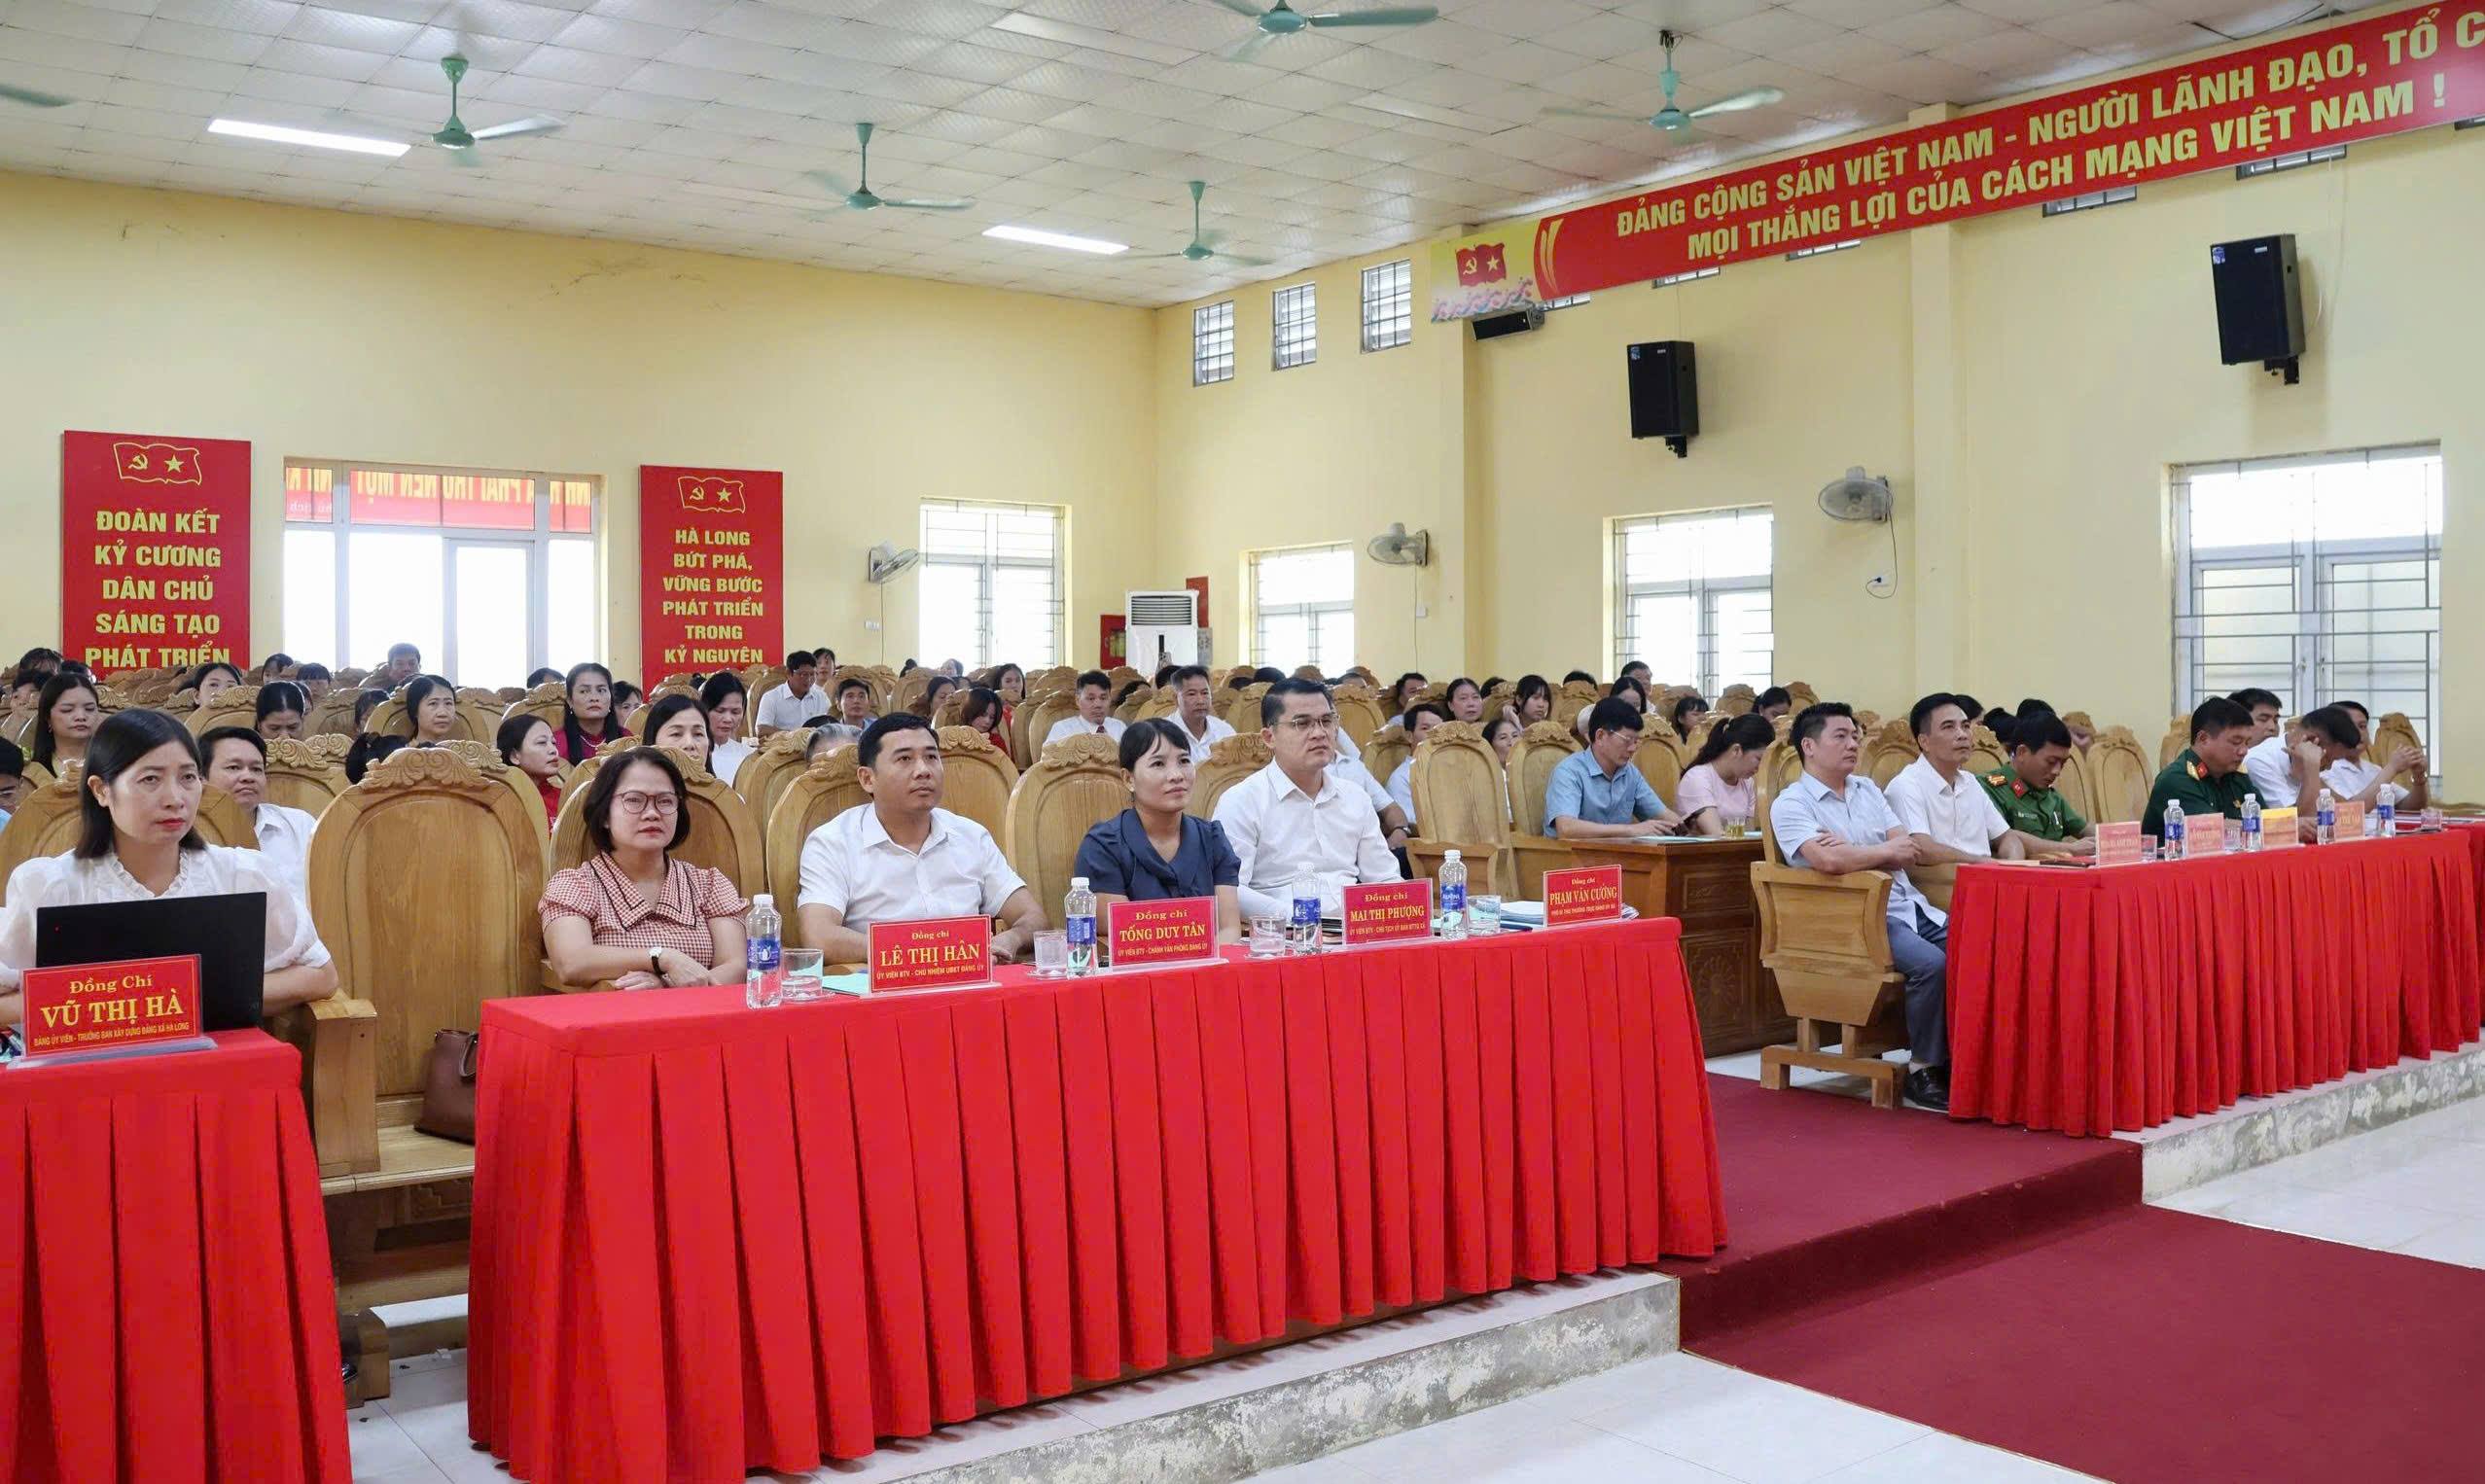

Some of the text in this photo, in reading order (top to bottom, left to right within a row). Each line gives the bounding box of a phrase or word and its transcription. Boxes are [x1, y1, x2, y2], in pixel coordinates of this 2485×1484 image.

[1616, 197, 1686, 237] ĐẢNG
[1694, 179, 1767, 222] CỘNG
[1776, 159, 1835, 201] SẢN
[1844, 147, 1907, 186] VIỆT
[1918, 127, 1993, 169] NAM
[2005, 133, 2017, 144] -
[2029, 90, 2139, 146] NGƯỜI
[2152, 66, 2254, 119] LÃNH
[2267, 43, 2367, 92] ĐẠO,
[2382, 7, 2441, 66] TỔ
[1687, 73, 2445, 261] MỌI THẮNG LỢI CỦA CÁCH MẠNG VIỆT NAM !
[96, 508, 221, 534] ĐOÀN KẾT
[675, 527, 751, 546] HÀ LONG
[94, 539, 222, 568] KỶ CƯƠNG
[673, 550, 753, 572] BỨT PHÁ,
[102, 574, 214, 600] DÂN CHỦ
[662, 575, 763, 593] VỮNG BƯỚC
[662, 596, 763, 617] PHÁT TRIỂN
[95, 609, 220, 639] SÁNG TẠO
[684, 624, 743, 640] TRONG
[85, 640, 231, 668] PHÁT TRIỂN
[664, 645, 763, 664] KỶ NGUYÊN
[1549, 891, 1572, 907] PHẠM
[1350, 905, 1425, 922] MAI THỊ PHƯỢNG
[1119, 921, 1205, 941] TỐNG DUY TÂN
[880, 939, 980, 967] LÊ THỊ HÂN
[69, 974, 154, 994] Đồng Chí
[40, 988, 184, 1029] VŨ THỊ HÀ
